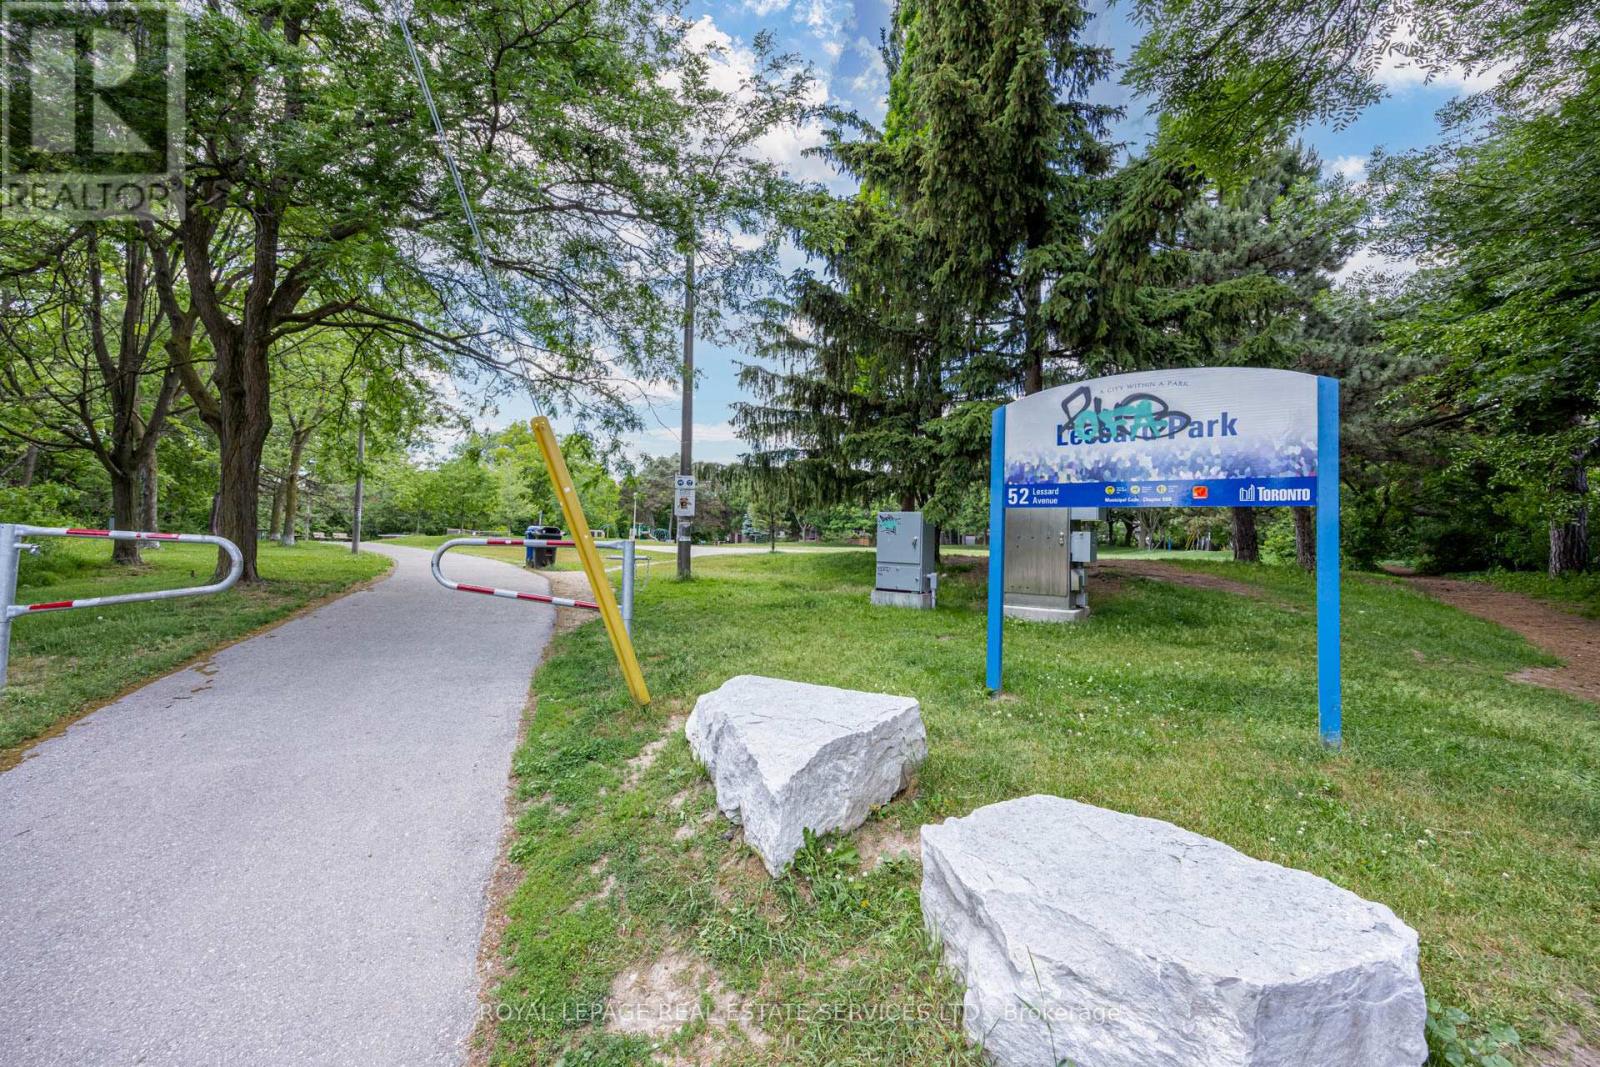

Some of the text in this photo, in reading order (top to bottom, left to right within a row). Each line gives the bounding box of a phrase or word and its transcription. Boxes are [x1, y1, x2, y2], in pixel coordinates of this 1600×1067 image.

[1168, 412, 1238, 439] Park
[1008, 487, 1029, 505] 52
[1032, 487, 1059, 495] Lessard
[1257, 486, 1311, 501] TORONTO
